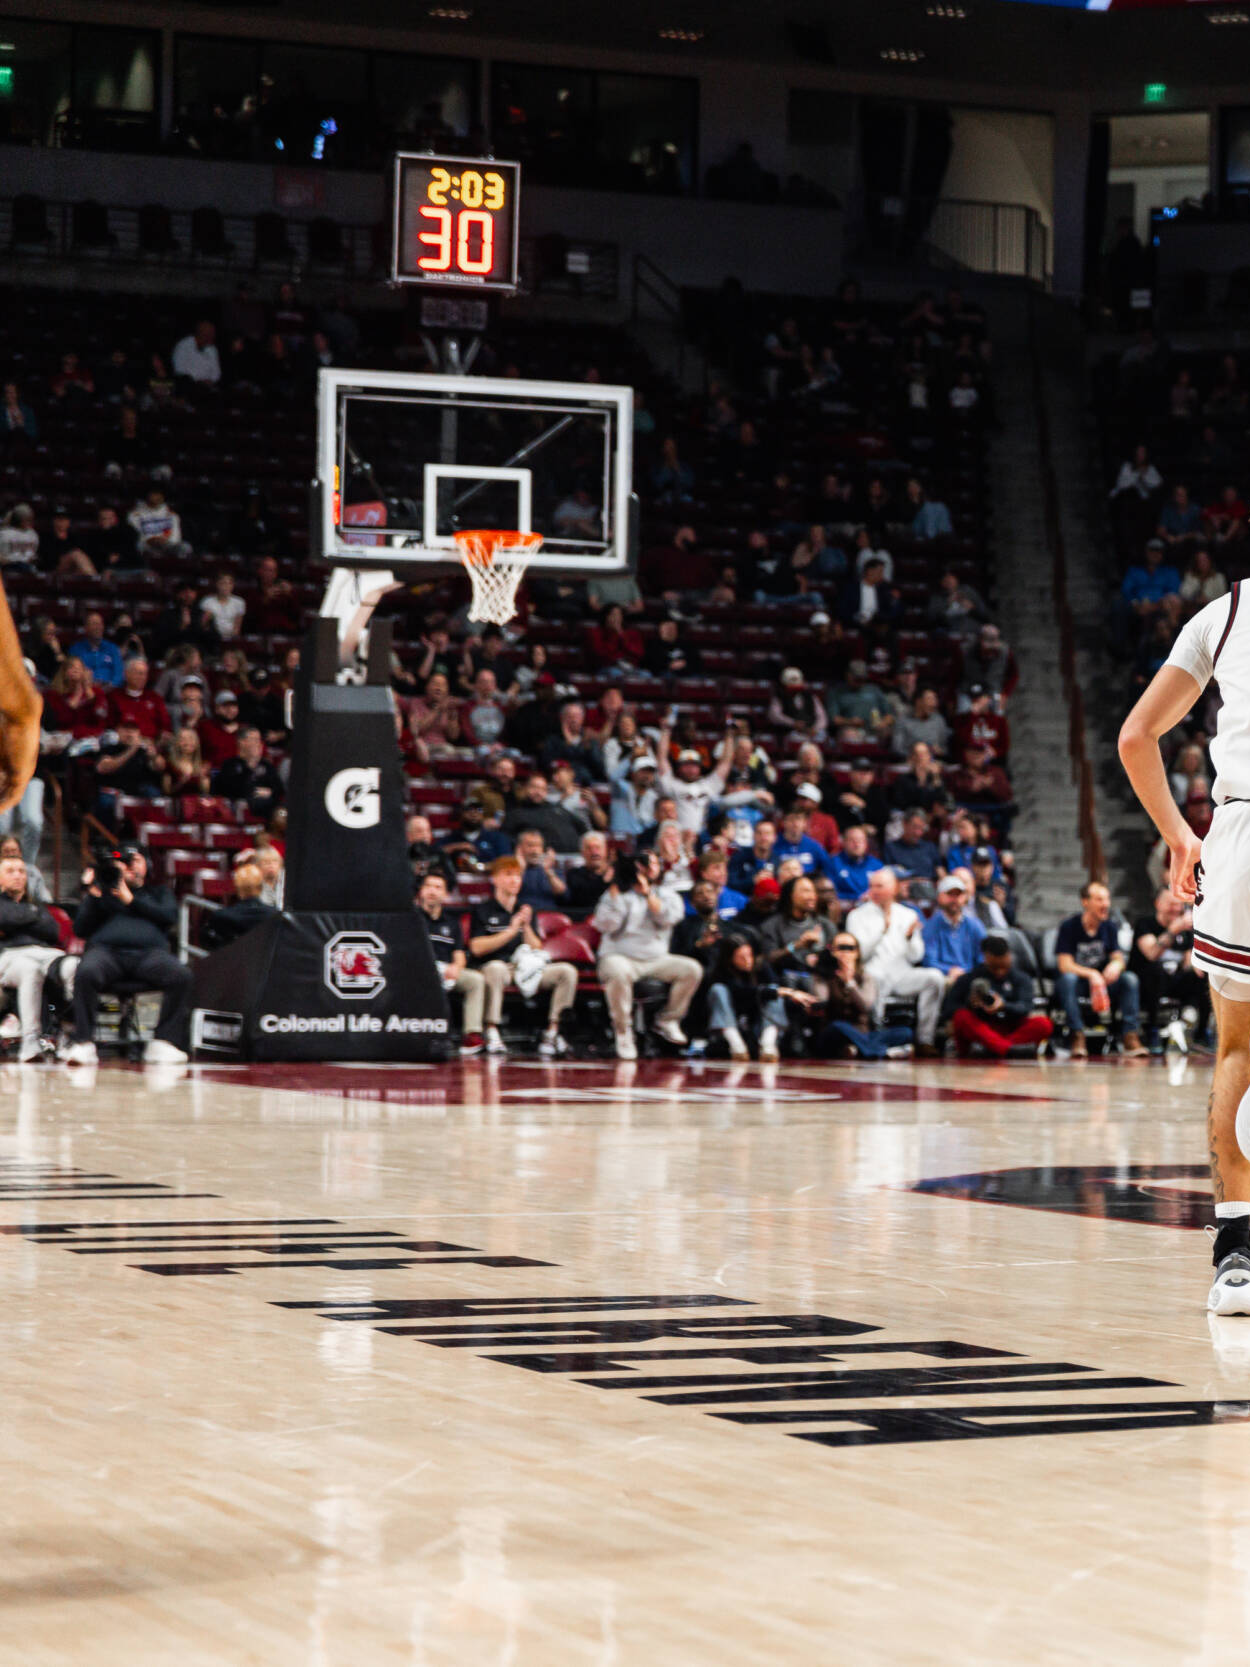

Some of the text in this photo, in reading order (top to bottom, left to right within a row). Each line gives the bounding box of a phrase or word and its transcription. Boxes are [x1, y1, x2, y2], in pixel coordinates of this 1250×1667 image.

[428, 168, 505, 210] 2:03
[418, 206, 494, 275] 30
[260, 1014, 345, 1033] Colonial
[348, 1014, 383, 1033] Life
[386, 1014, 448, 1033] Arena
